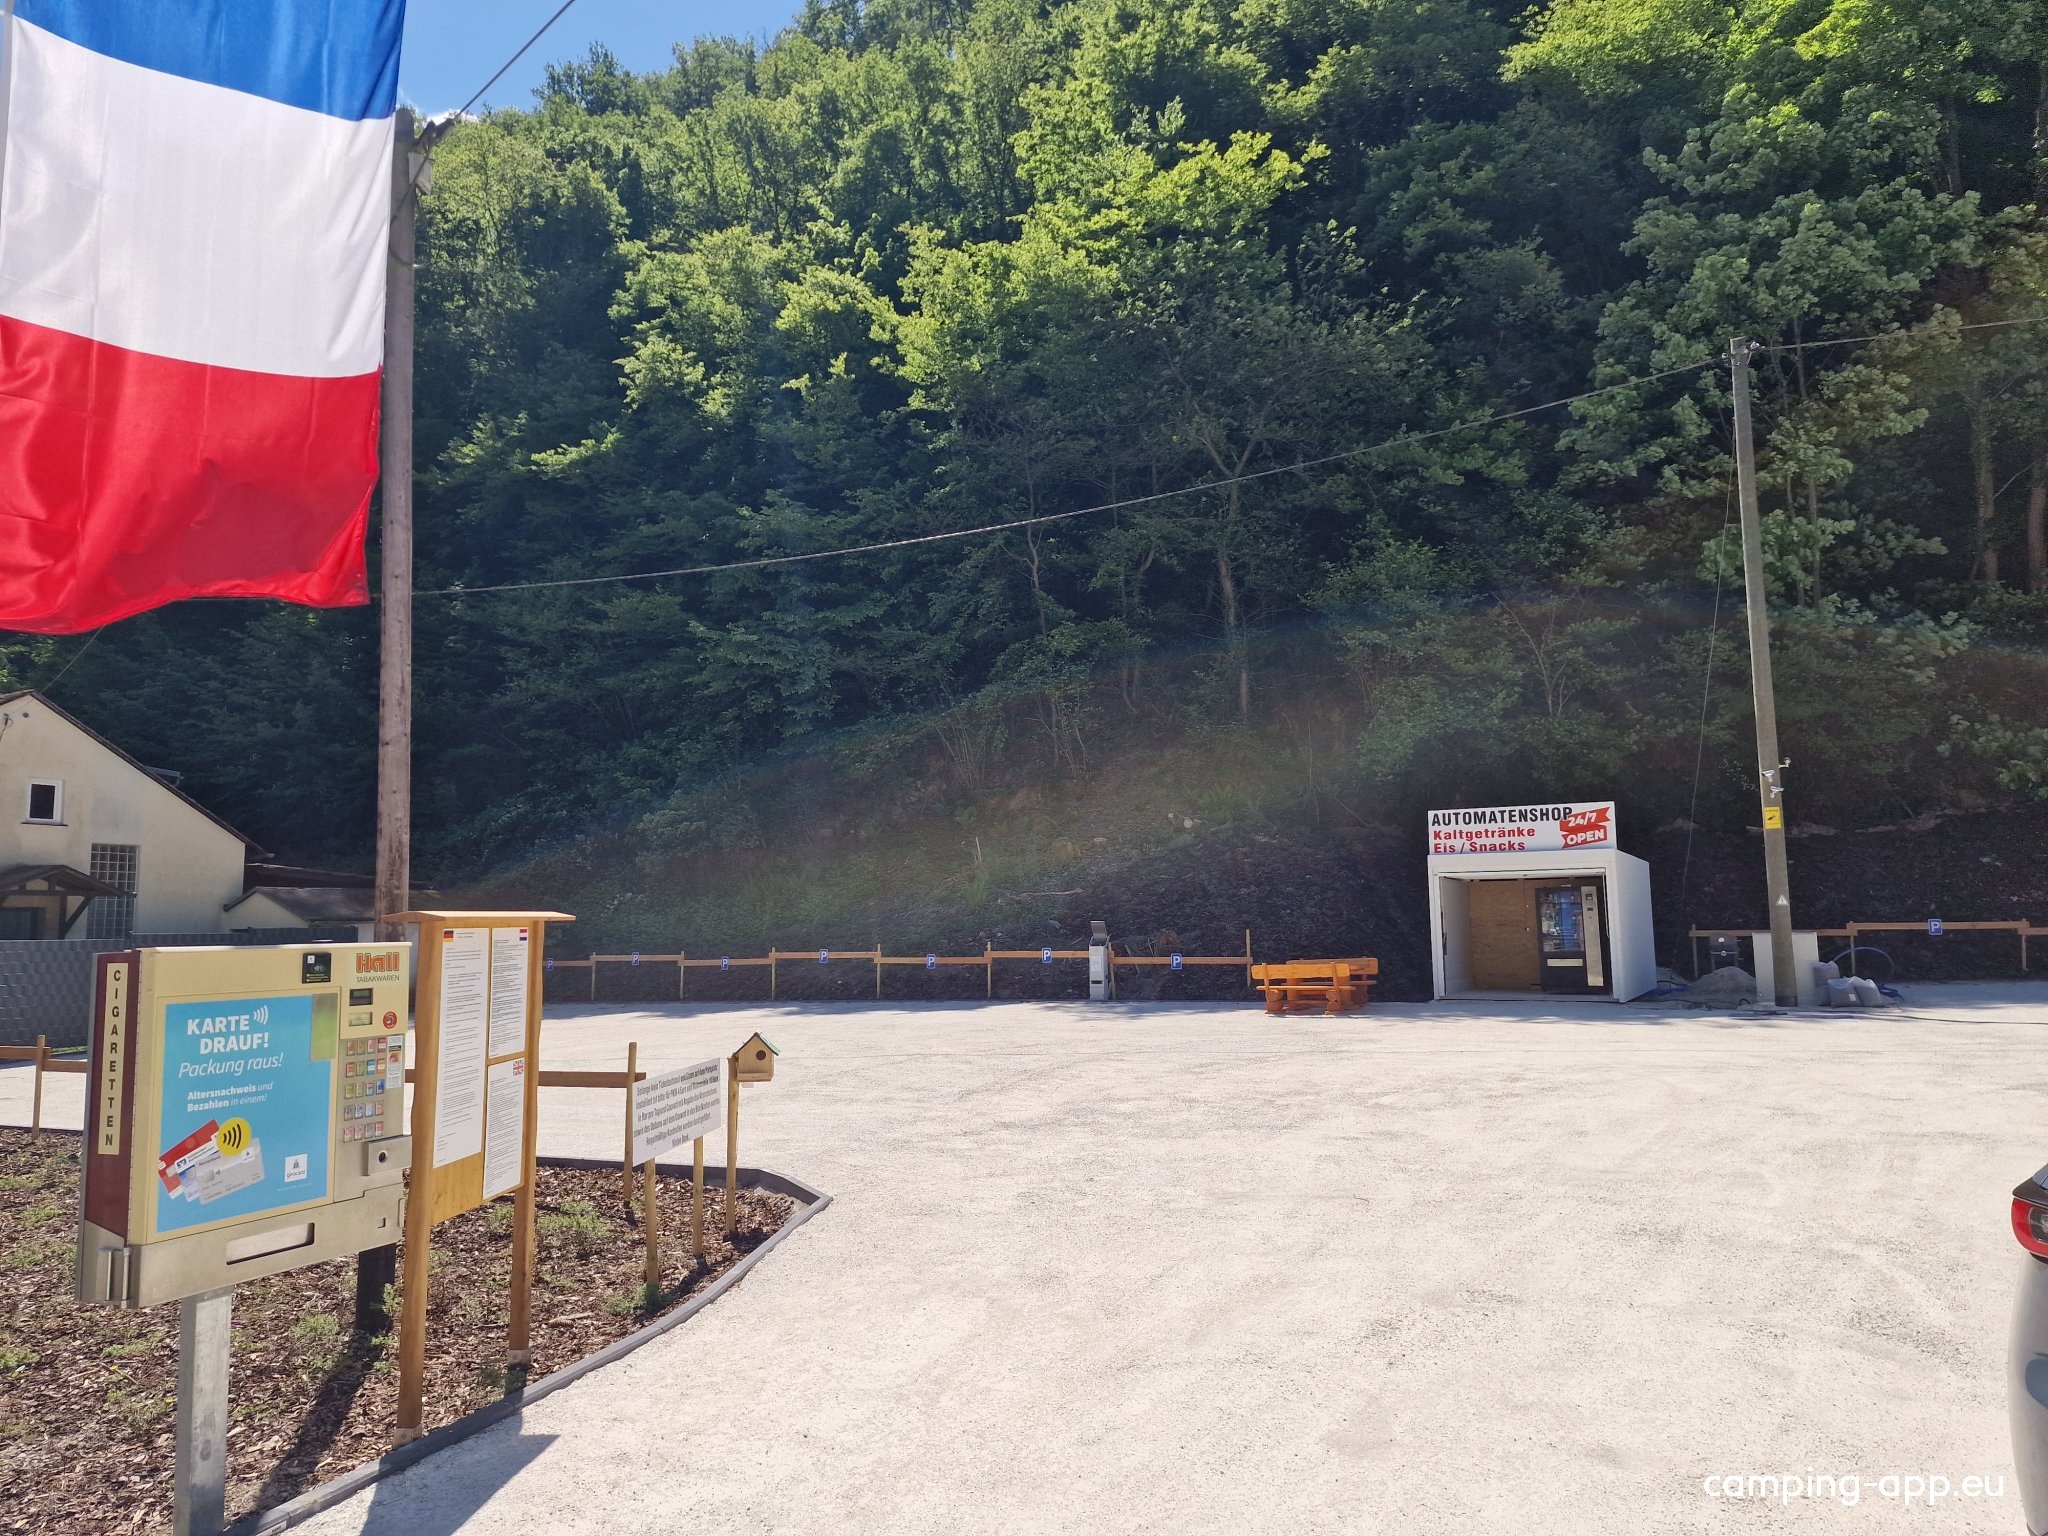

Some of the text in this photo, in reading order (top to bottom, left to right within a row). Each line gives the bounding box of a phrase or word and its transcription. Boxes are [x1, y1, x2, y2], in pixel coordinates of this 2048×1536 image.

[1431, 806, 1573, 826] AUTOMATENSHOP
[1568, 812, 1597, 827] 24/7
[1433, 826, 1536, 841] Kaltgetränke
[1567, 828, 1605, 844] OPEN
[1433, 843, 1456, 854] Eis
[1469, 840, 1526, 852] Snacks
[356, 952, 400, 973] Hall
[356, 974, 400, 983] TABAKWAREN
[187, 1014, 250, 1035] KARTE
[200, 1032, 269, 1054] DRAUF!
[105, 969, 121, 1147] CIGARETTEN
[179, 1052, 284, 1078] Packung raus!
[187, 1081, 274, 1101] Altersnachweis und
[187, 1100, 230, 1112] Bezahlen
[240, 1093, 267, 1105] einem!
